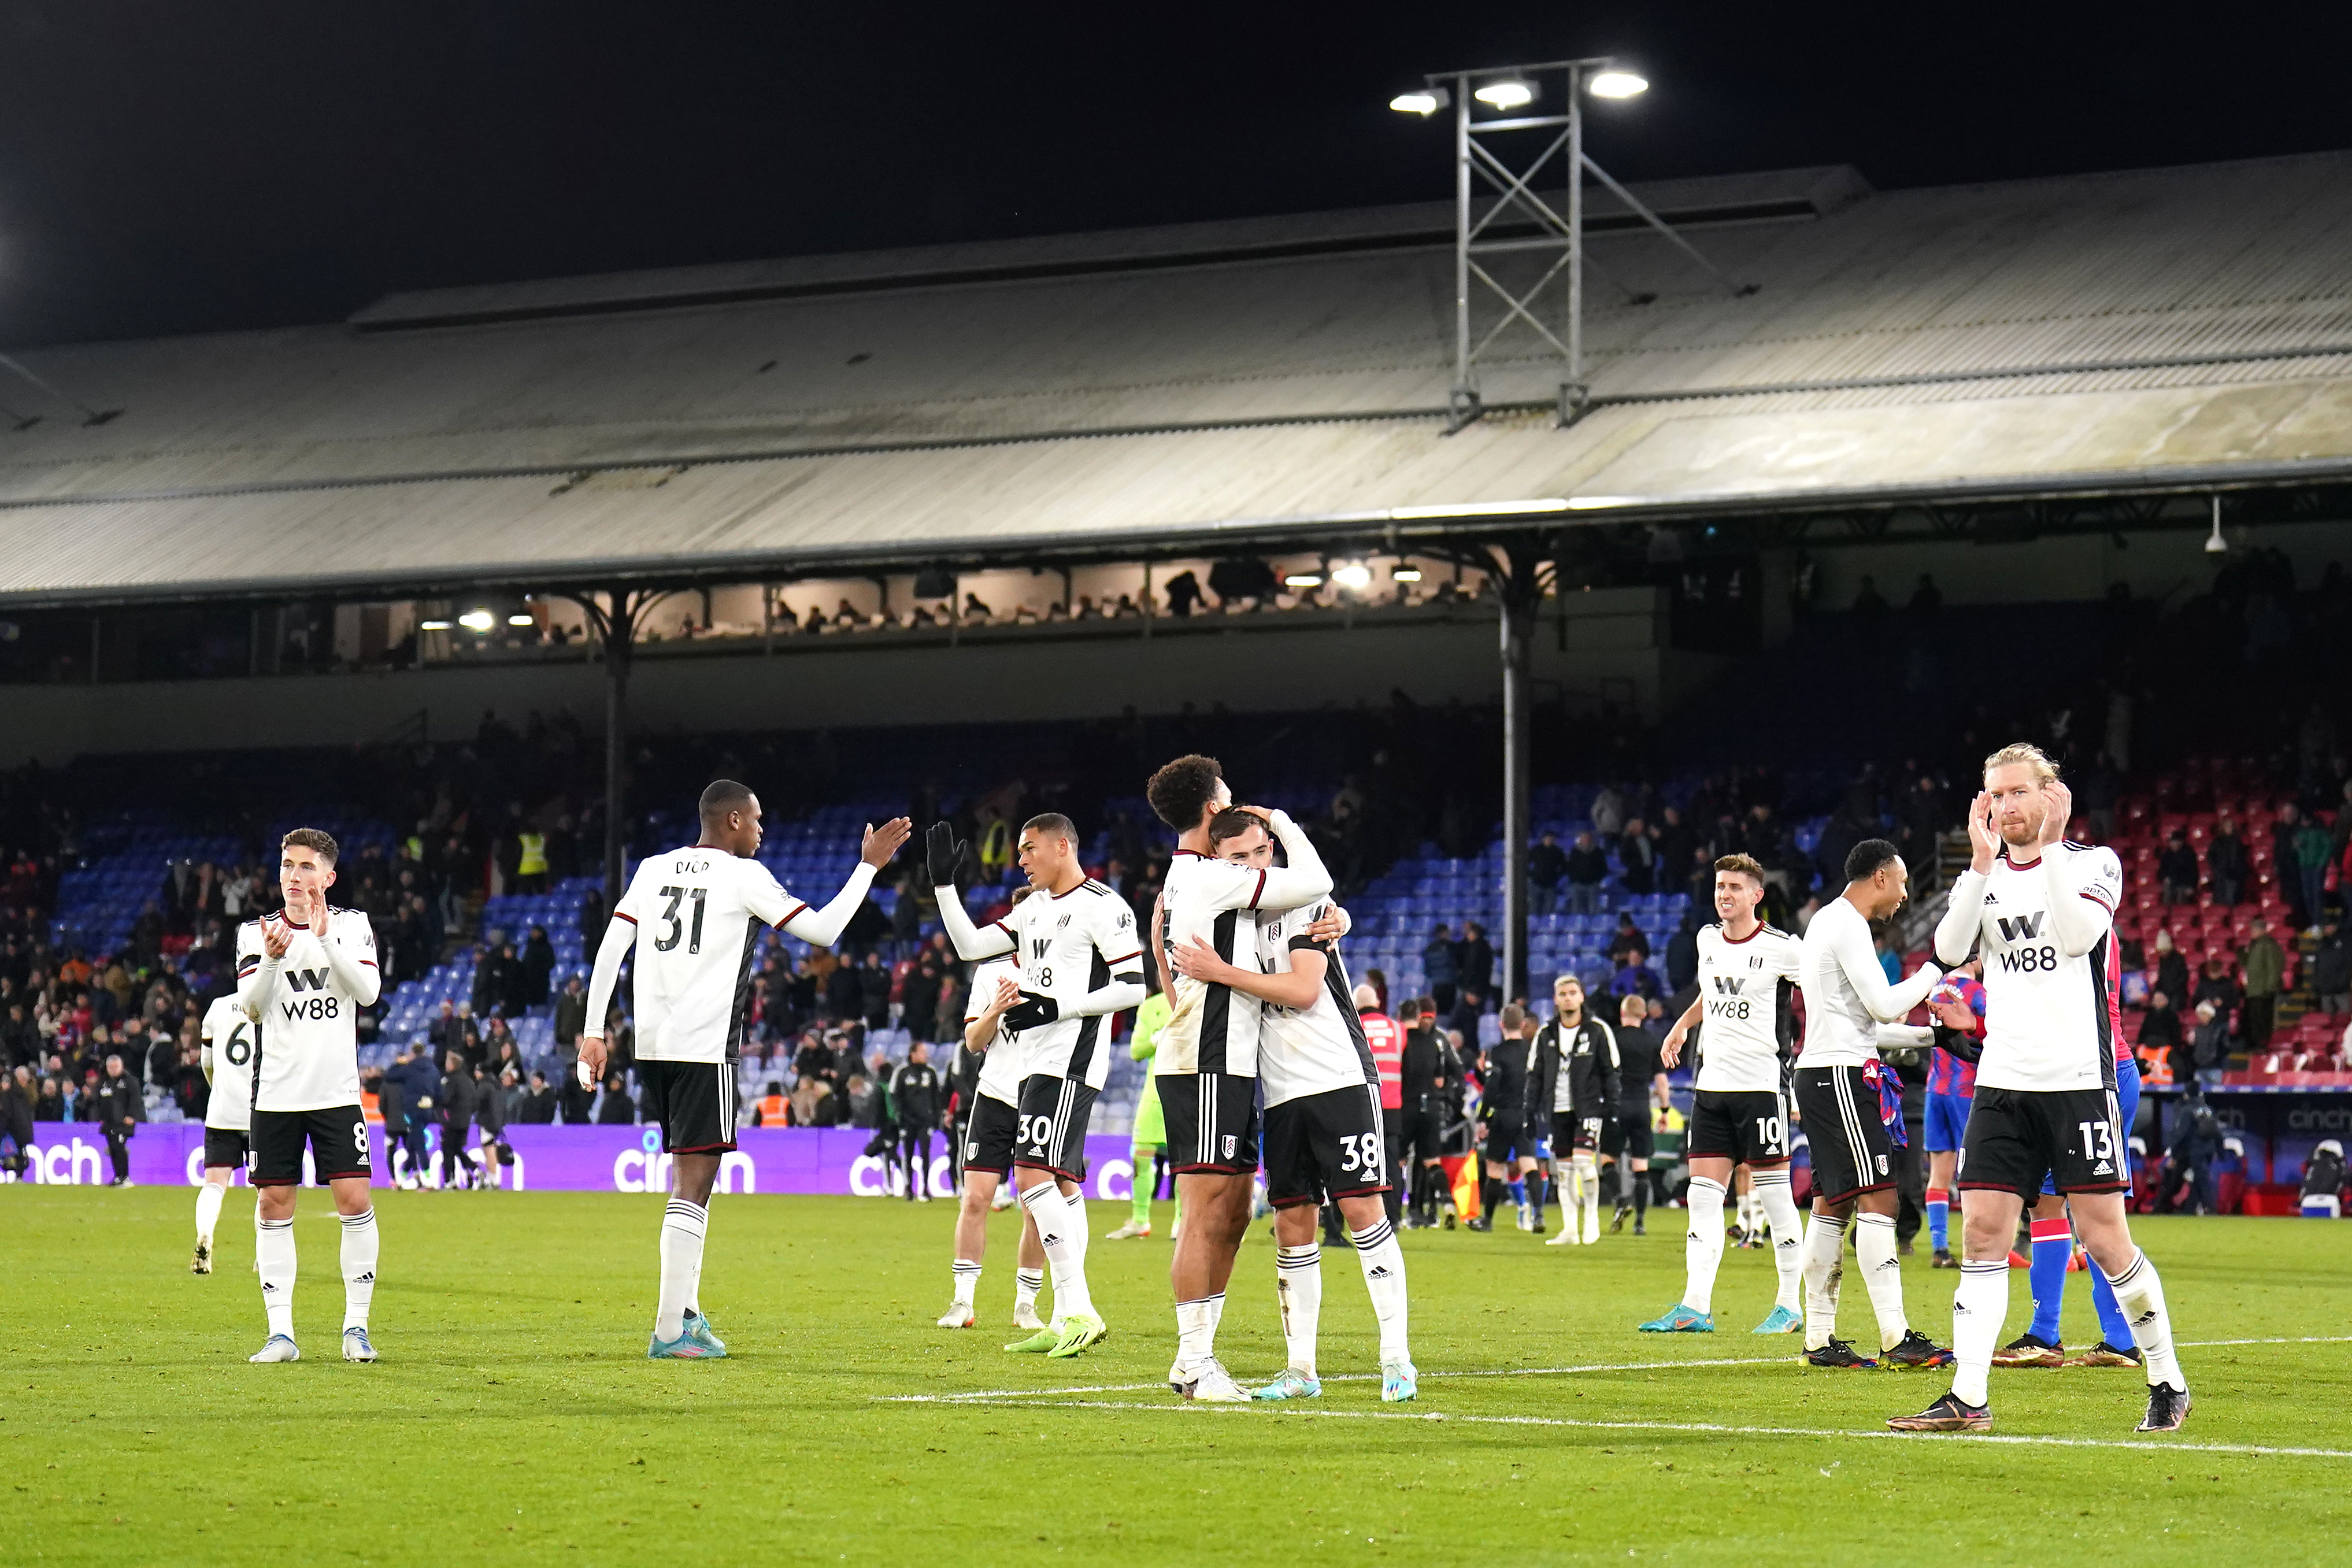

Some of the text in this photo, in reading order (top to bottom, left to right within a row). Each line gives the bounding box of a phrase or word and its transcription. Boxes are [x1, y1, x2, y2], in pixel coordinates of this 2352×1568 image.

[654, 886, 708, 954] 31
[1998, 911, 2044, 942] W
[2000, 946, 2057, 974] W88
[285, 967, 330, 992] W
[1714, 976, 1746, 995] W
[282, 997, 339, 1022] W88
[1709, 1000, 1750, 1020] W88
[225, 1022, 250, 1066] 6
[353, 1122, 368, 1153] 8
[1017, 1114, 1052, 1146] 30
[1757, 1117, 1781, 1144] 10
[2079, 1121, 2113, 1161] 13
[1339, 1132, 1379, 1172] 38
